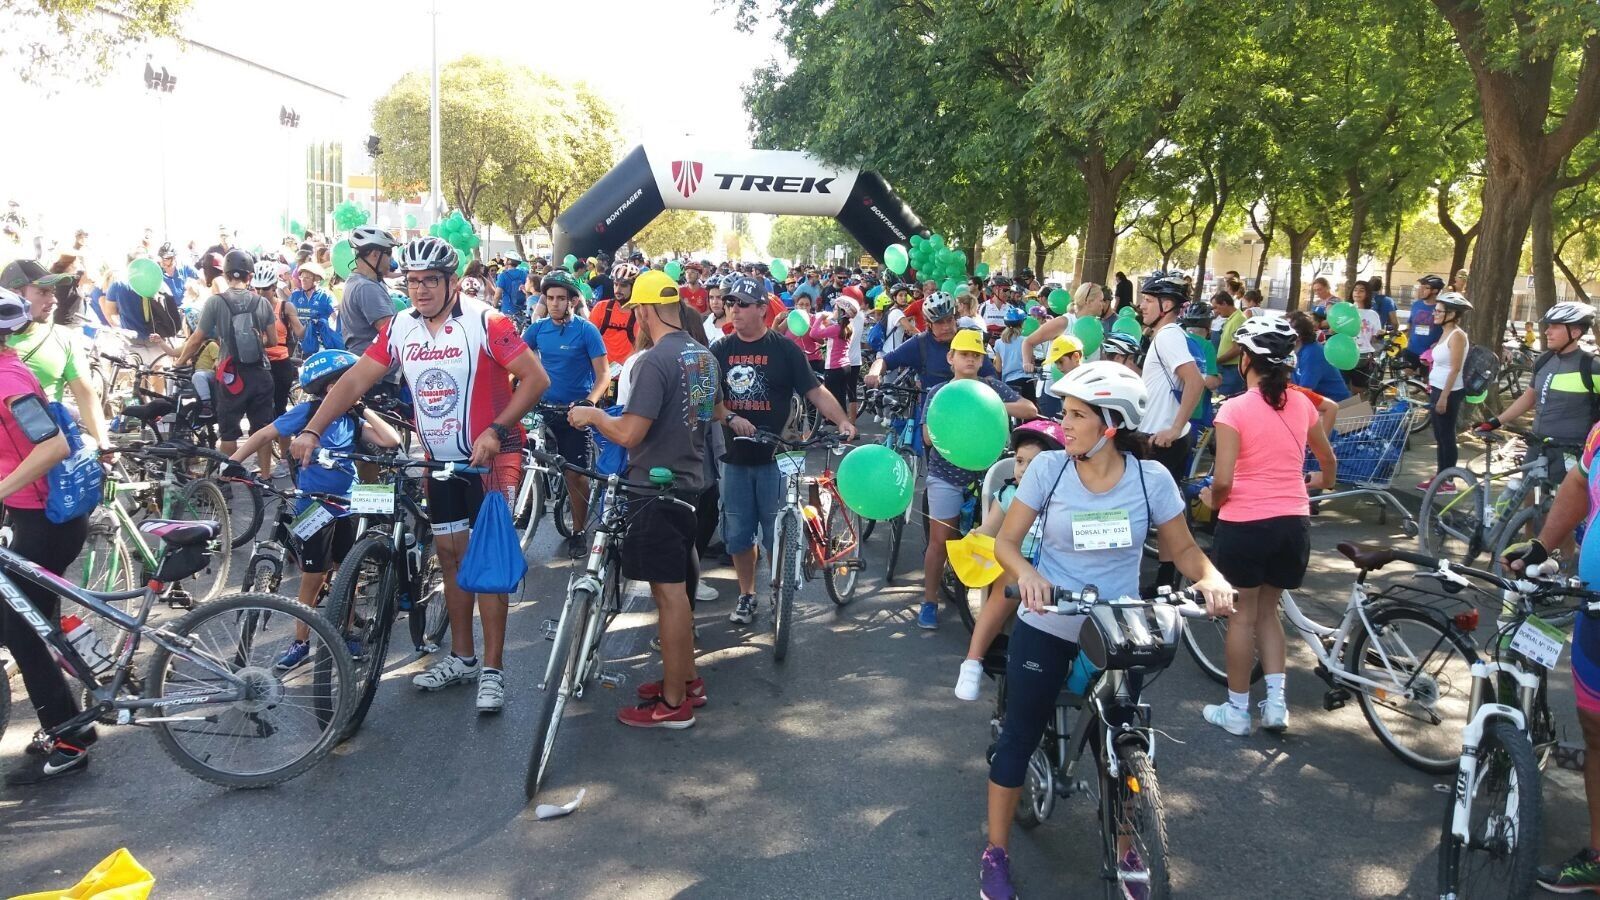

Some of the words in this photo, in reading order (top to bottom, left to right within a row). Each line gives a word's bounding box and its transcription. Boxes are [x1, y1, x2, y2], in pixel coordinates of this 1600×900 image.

[714, 173, 837, 194] TREK
[605, 188, 643, 226] BONTRAGER
[870, 205, 907, 241] BONTRAGER
[744, 284, 753, 294] 16
[405, 342, 463, 361] Tikitaka
[728, 354, 769, 366] SAVAGE
[426, 404, 446, 412] JEREZ
[722, 399, 772, 411] OOTBALL
[297, 521, 313, 535] DORSAL
[1075, 528, 1102, 536] DORSAL
[1518, 629, 1538, 645] DORSAL
[152, 696, 209, 708] megamo
[1456, 769, 1469, 808] FOX
